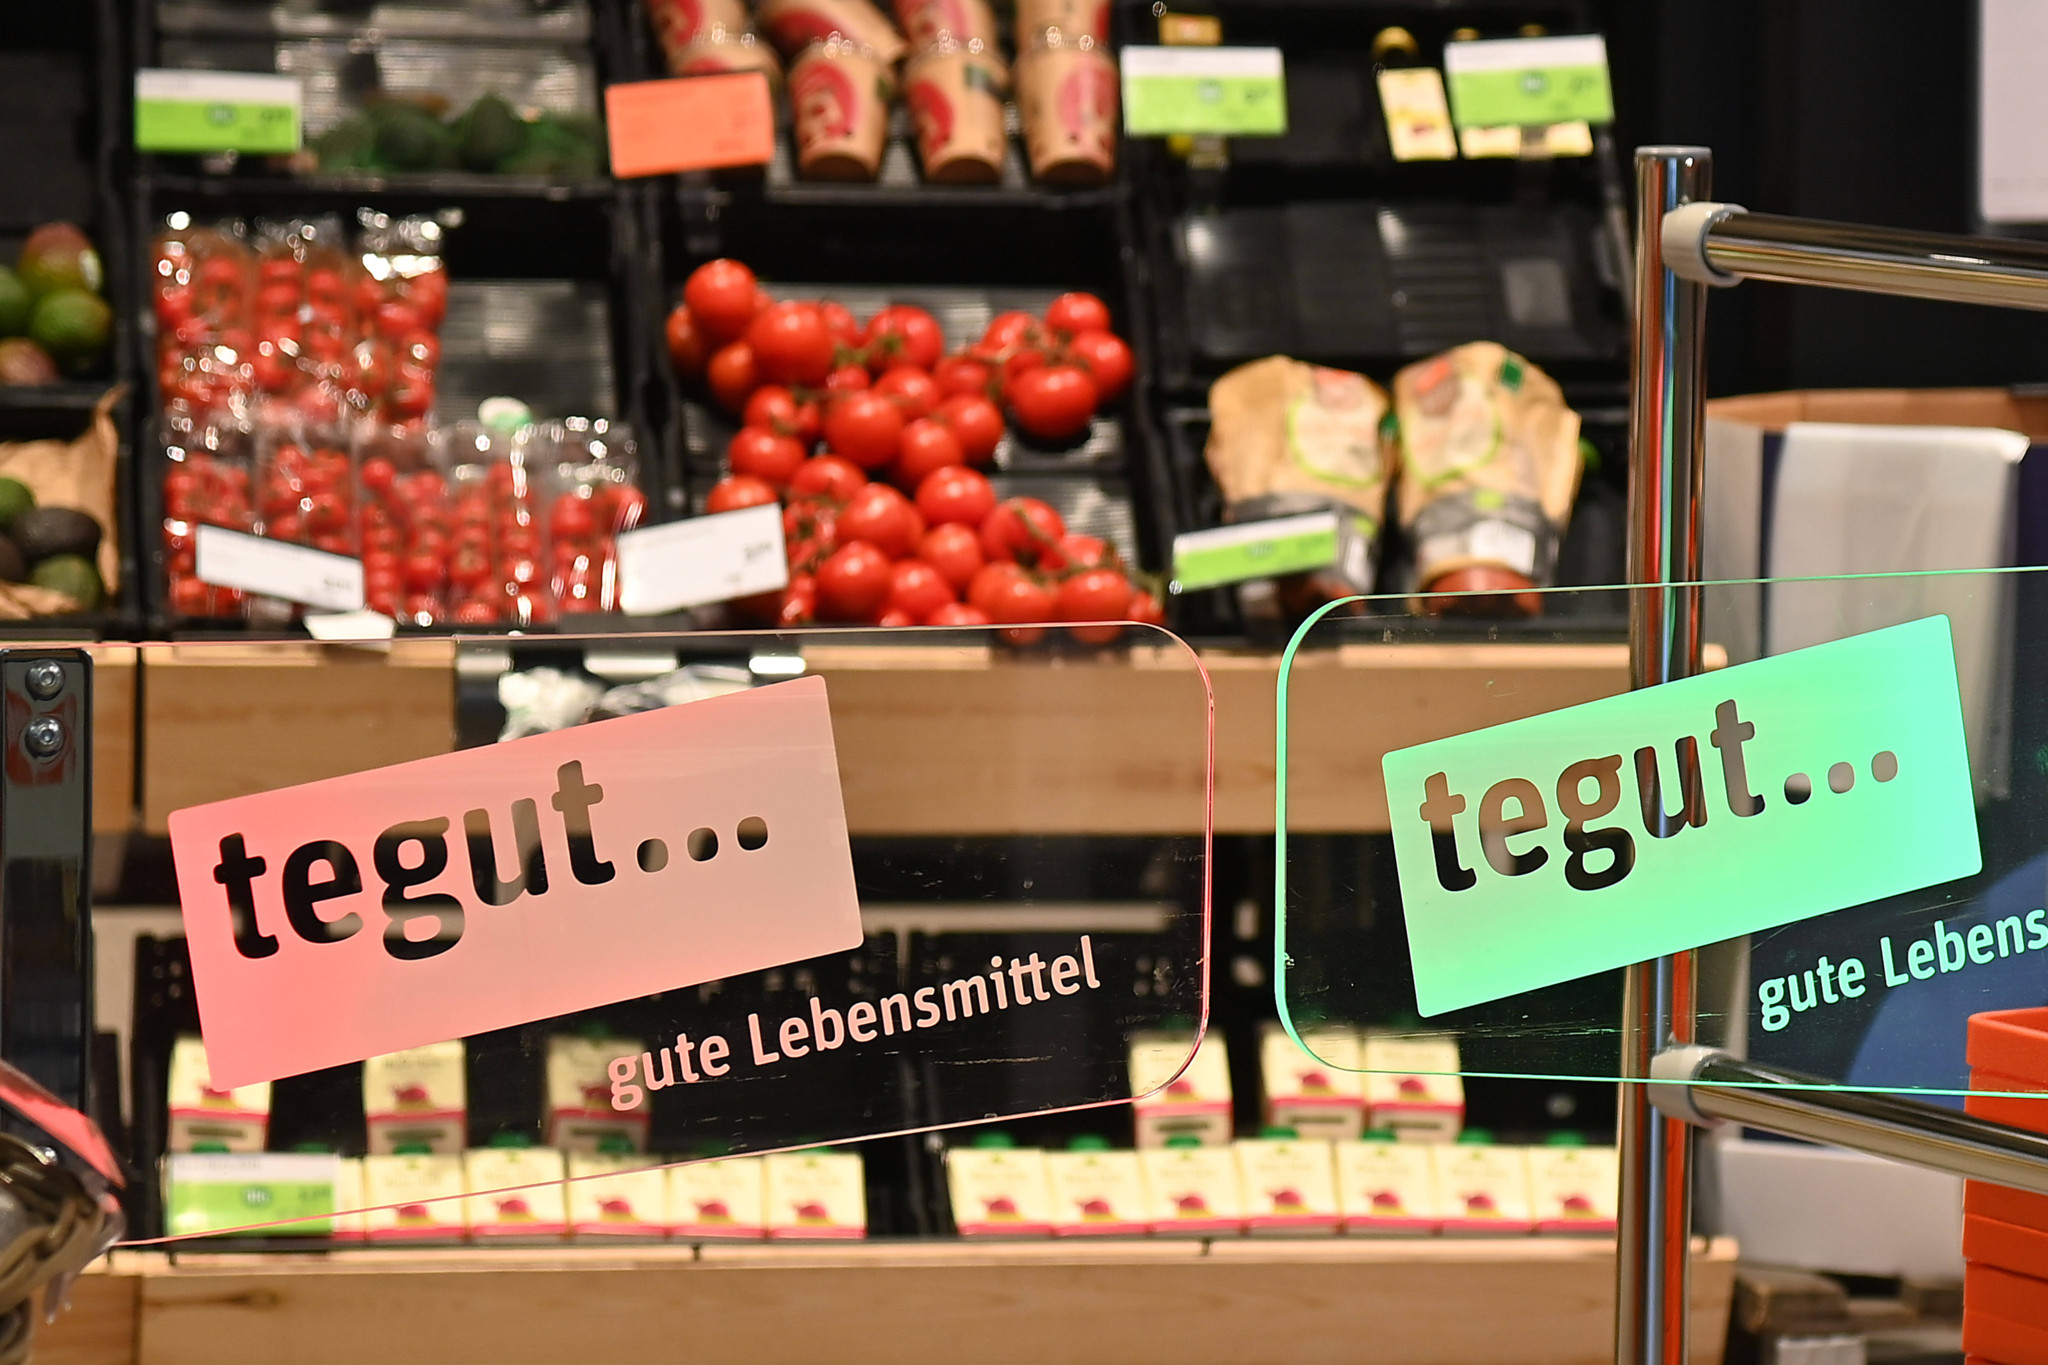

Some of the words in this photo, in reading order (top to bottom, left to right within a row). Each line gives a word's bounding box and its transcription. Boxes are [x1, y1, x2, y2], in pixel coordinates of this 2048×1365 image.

[213, 759, 770, 961] tegut...
[1418, 698, 1900, 893] tegut...
[607, 1033, 731, 1112] gute
[748, 935, 1102, 1066] Lebensmittel
[1758, 956, 1866, 1032] gute
